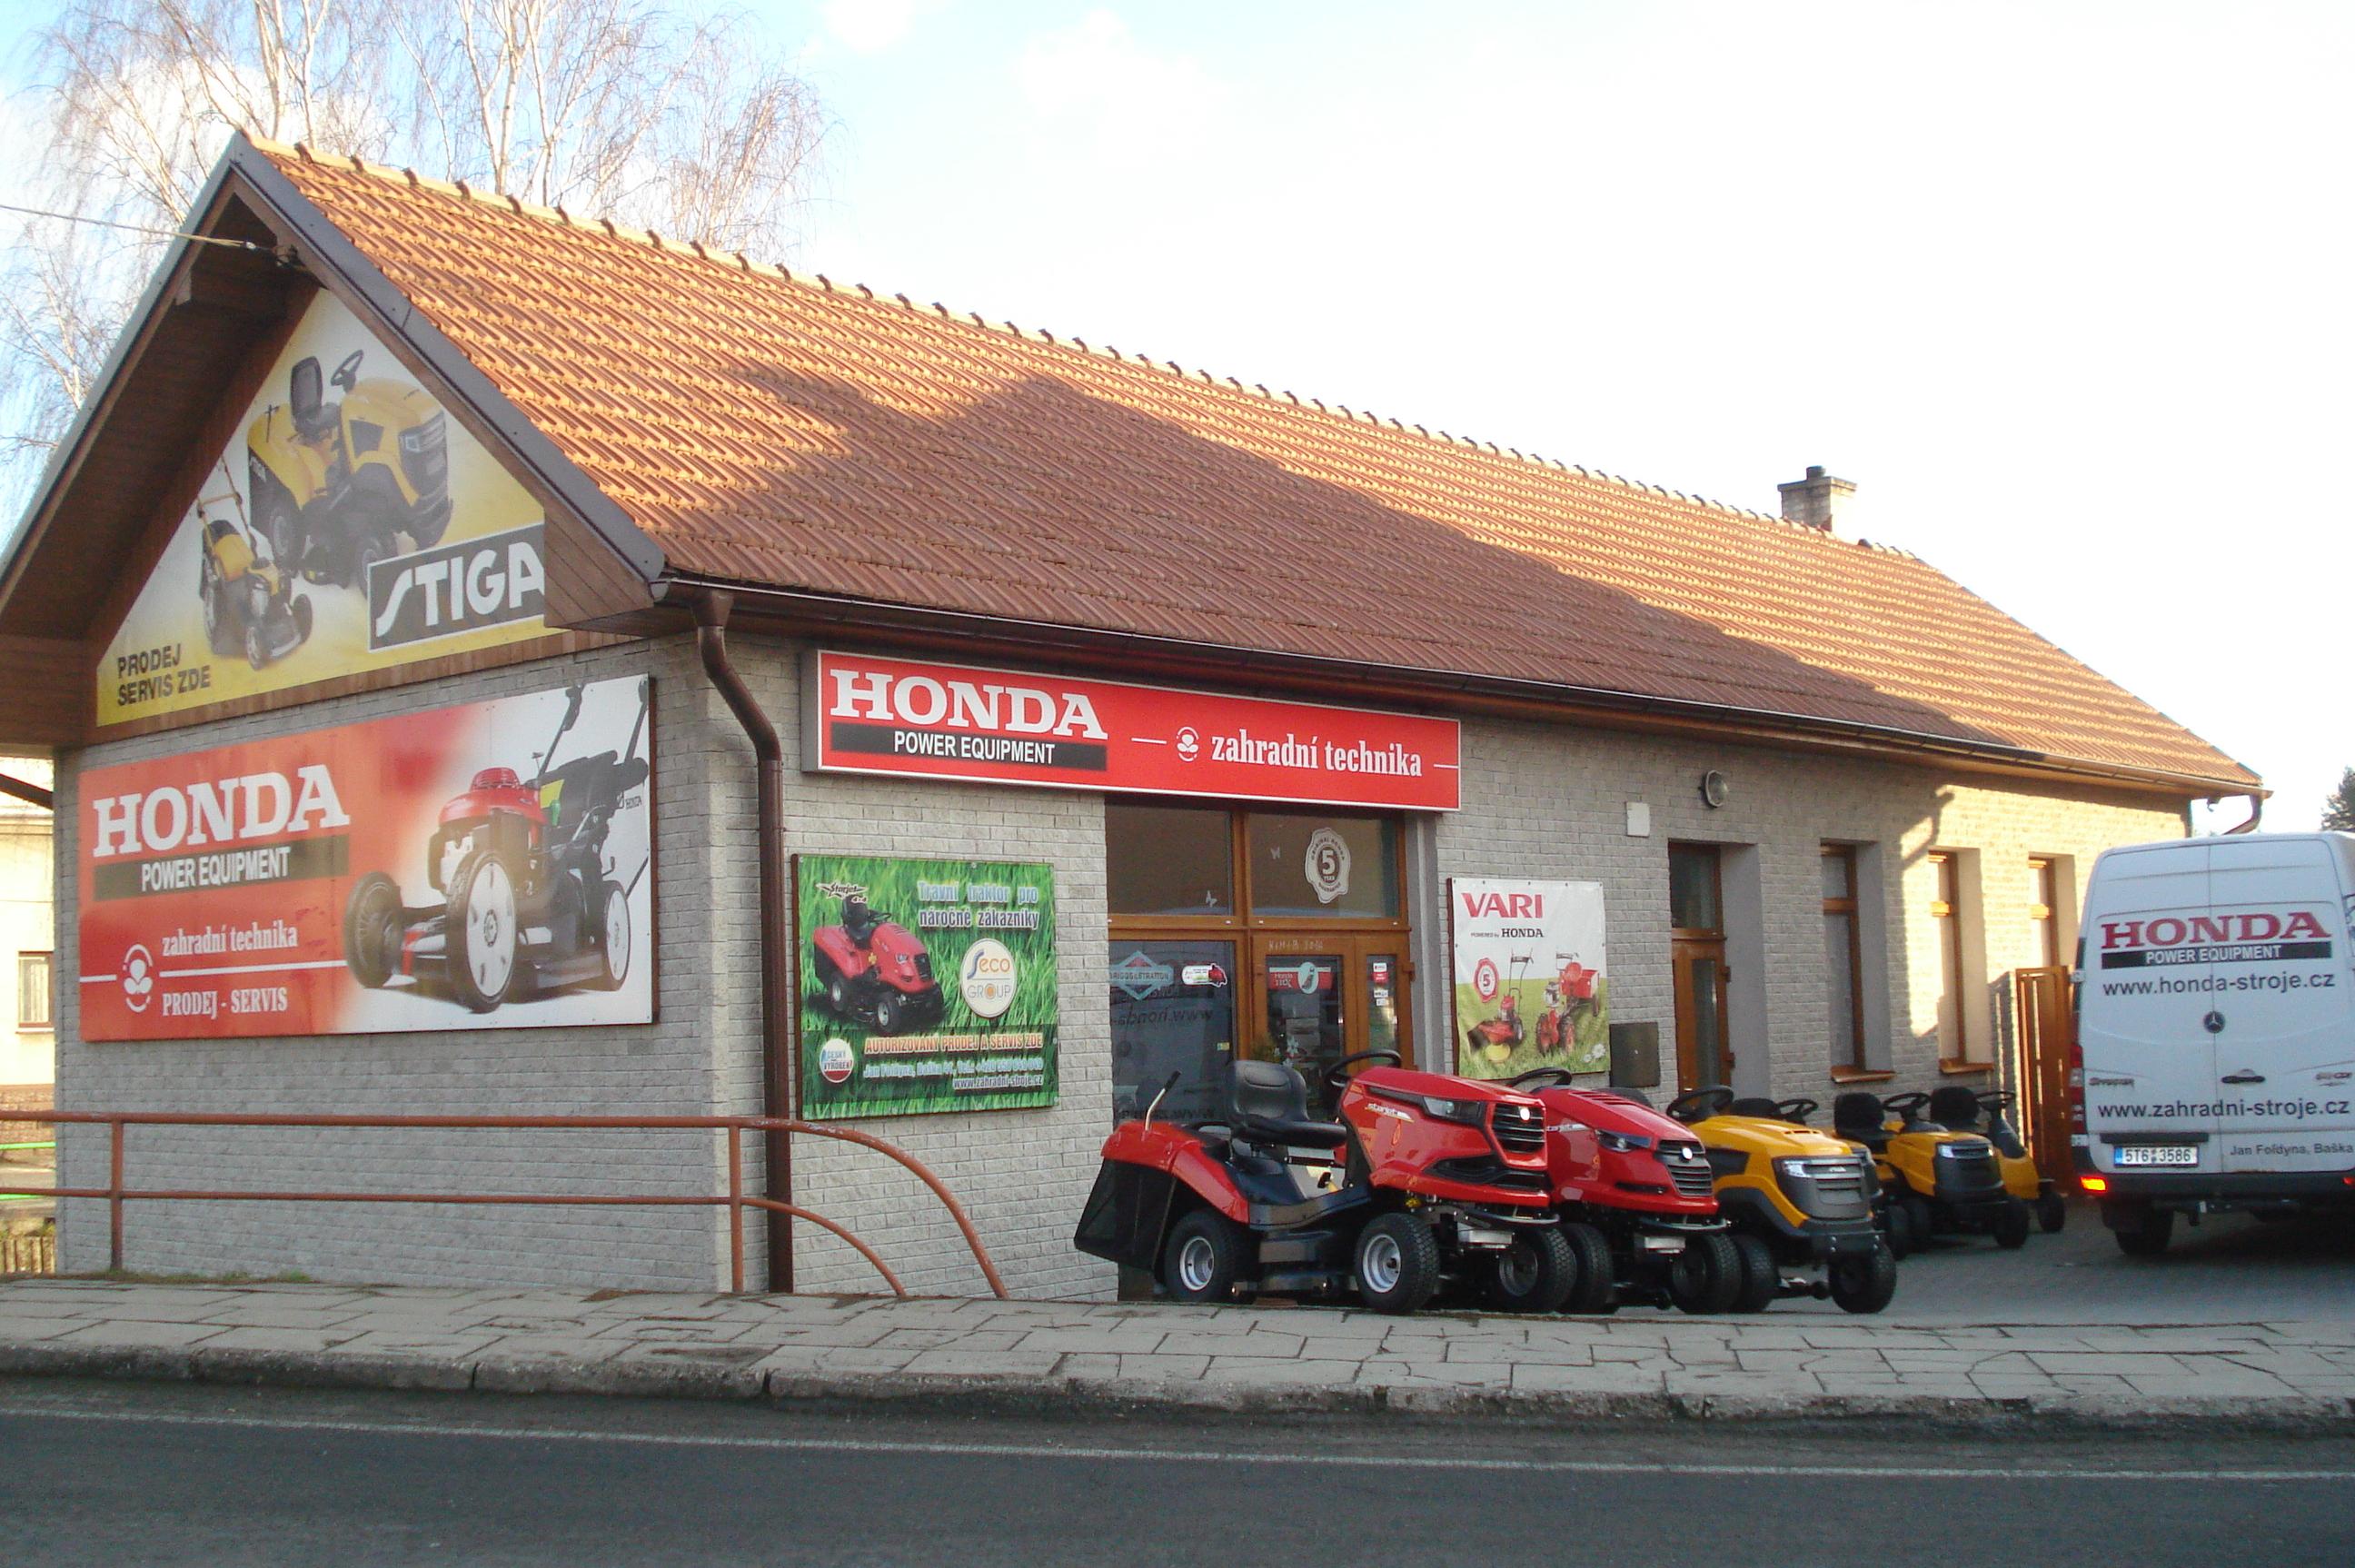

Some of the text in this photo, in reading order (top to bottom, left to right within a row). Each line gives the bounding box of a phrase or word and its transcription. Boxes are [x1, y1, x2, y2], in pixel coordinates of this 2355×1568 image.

[375, 541, 545, 638] STIGA
[117, 643, 182, 679] PRODEJ
[117, 665, 211, 706] SERVIS ZDE
[830, 669, 1108, 740] HONDA
[894, 730, 1056, 765] POWER EQUIPMENT
[1211, 729, 1423, 777] zahradní technika
[93, 764, 351, 858] HONDA
[141, 847, 291, 892] POWER EQUIPMENT
[1322, 849, 1336, 875] 5
[918, 880, 1039, 904] Travní traktor pro
[919, 908, 1039, 928] náročné zákazníky
[1461, 893, 1543, 918] VARI
[162, 919, 298, 957] zahradní technika
[1502, 928, 1544, 938] HONDA
[2102, 912, 2331, 949] HONDA
[967, 949, 1010, 980] Seco
[2145, 945, 2281, 964] POWER EQUIPMENT
[967, 983, 1011, 999] GROUP
[1483, 974, 1490, 987] 5
[2102, 971, 2335, 996] www.honda-stroje.cz
[162, 991, 218, 1019] PRODEJ
[231, 987, 287, 1013] SERVIS
[865, 1032, 1043, 1054] AUTORIZOVANÝ PRODEJ A SERVIS ZDE
[2098, 1098, 2350, 1119] www.zahradni-stroje.cz
[2125, 1147, 2191, 1162] 5T6 3586
[2231, 1146, 2252, 1156] Jan
[2314, 1143, 2354, 1154] Baška
